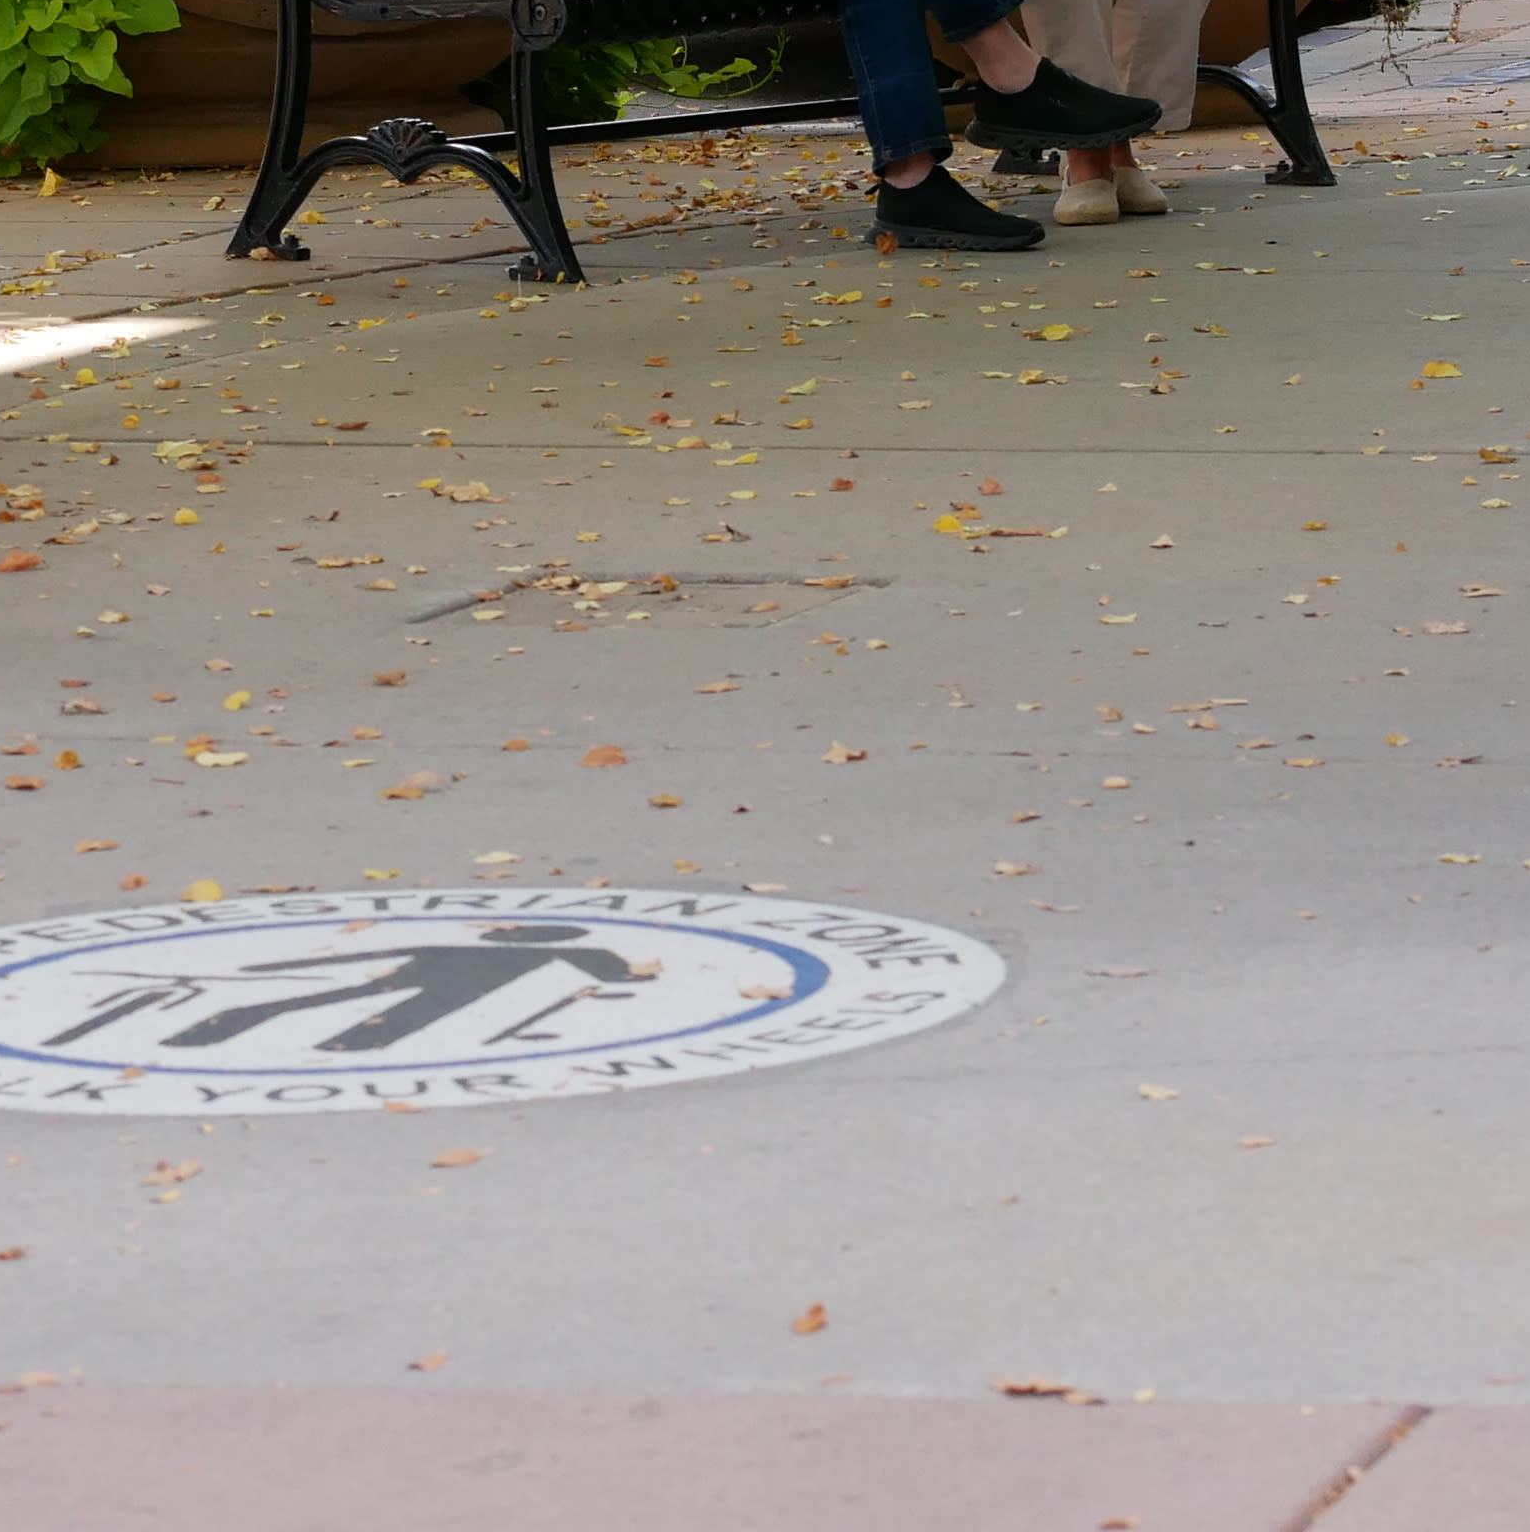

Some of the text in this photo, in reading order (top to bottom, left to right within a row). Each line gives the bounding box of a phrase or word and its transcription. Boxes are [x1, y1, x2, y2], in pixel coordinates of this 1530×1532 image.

[749, 912, 962, 970] ZONE
[194, 1072, 534, 1104] YOUR
[569, 989, 947, 1077] WHEELS
